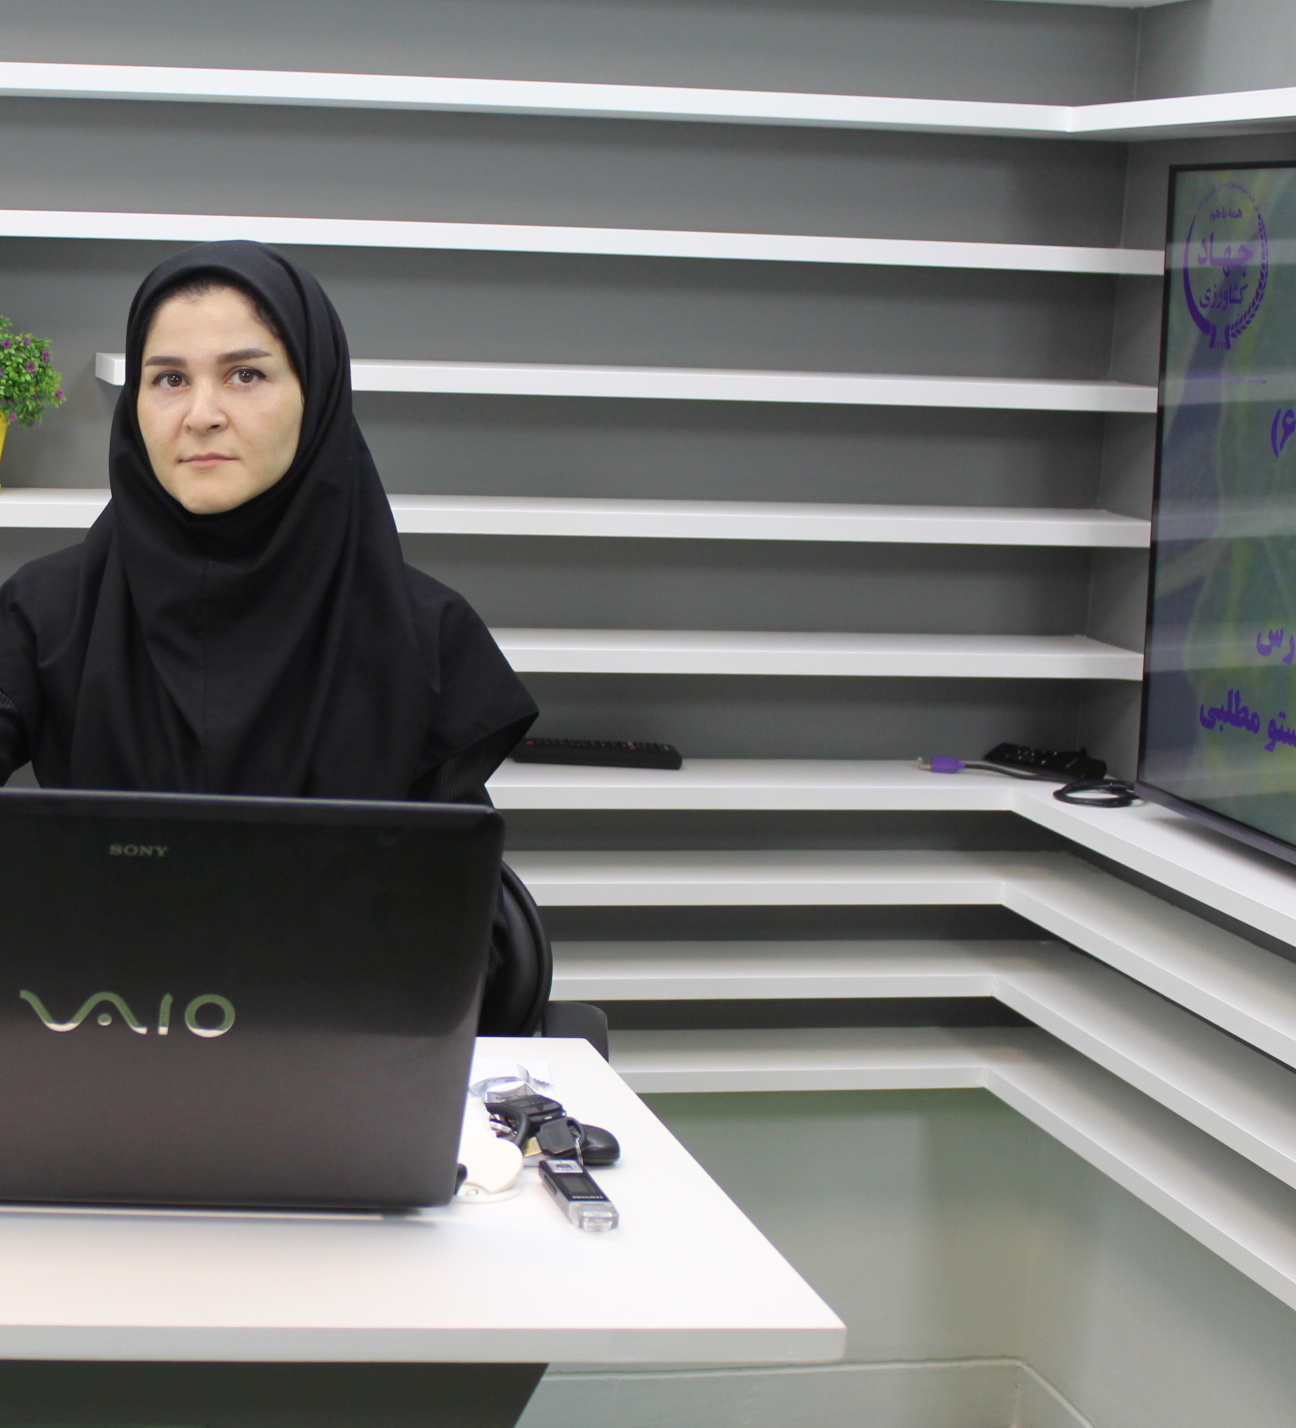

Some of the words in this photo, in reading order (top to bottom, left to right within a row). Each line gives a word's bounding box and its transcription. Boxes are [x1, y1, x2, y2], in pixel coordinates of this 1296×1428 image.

[1197, 231, 1254, 278] جهاد
[1199, 283, 1249, 311] کشاورزی
[1199, 688, 1260, 734] مطلبی
[109, 844, 170, 857] SONY
[19, 989, 236, 1038] VAIO
